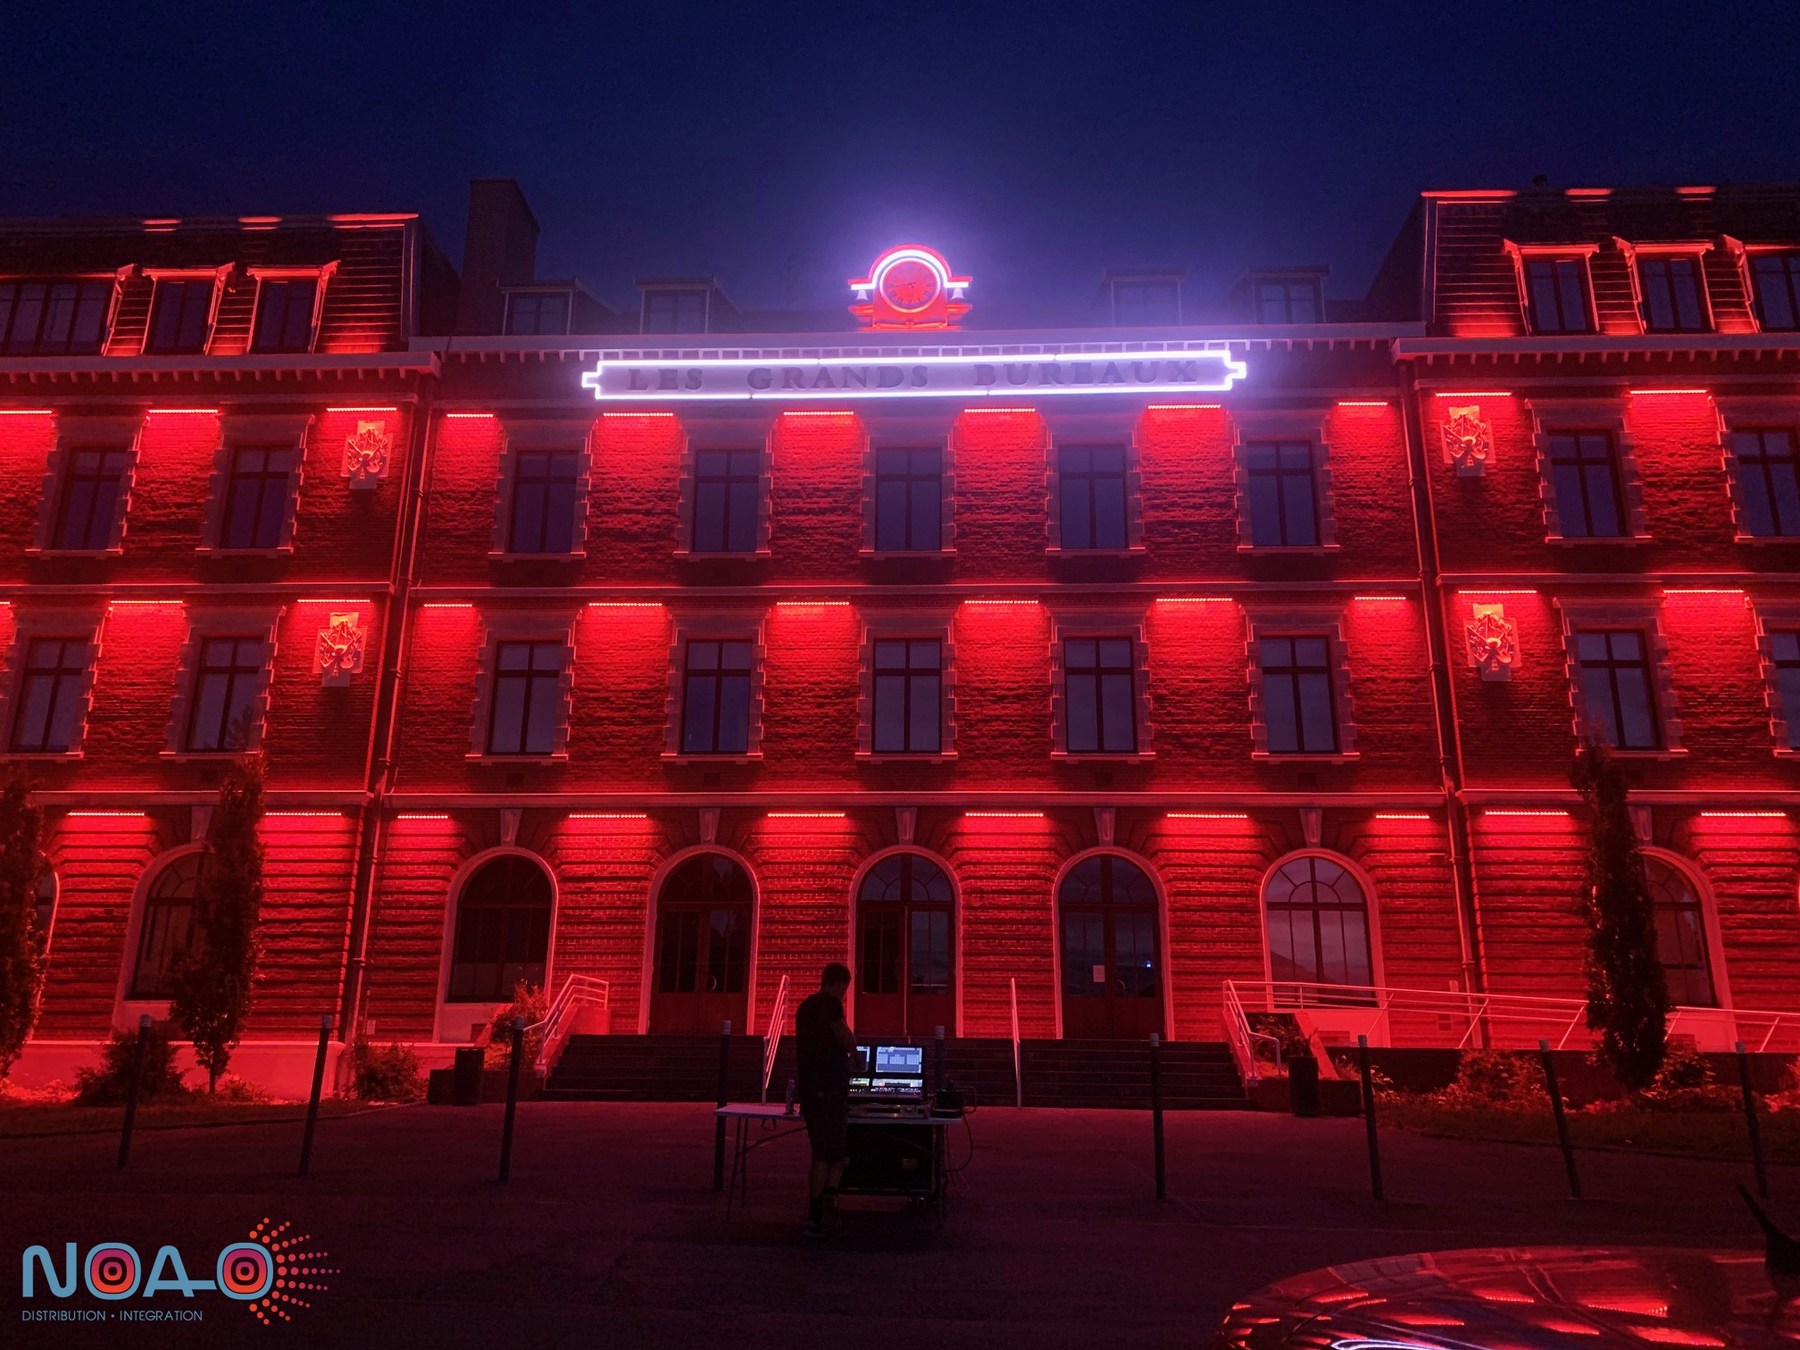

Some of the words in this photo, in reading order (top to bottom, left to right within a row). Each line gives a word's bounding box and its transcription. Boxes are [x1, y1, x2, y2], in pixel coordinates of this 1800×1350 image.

[627, 367, 704, 391] LES
[747, 365, 928, 391] GRANDS
[973, 360, 1198, 387] BUREAUX
